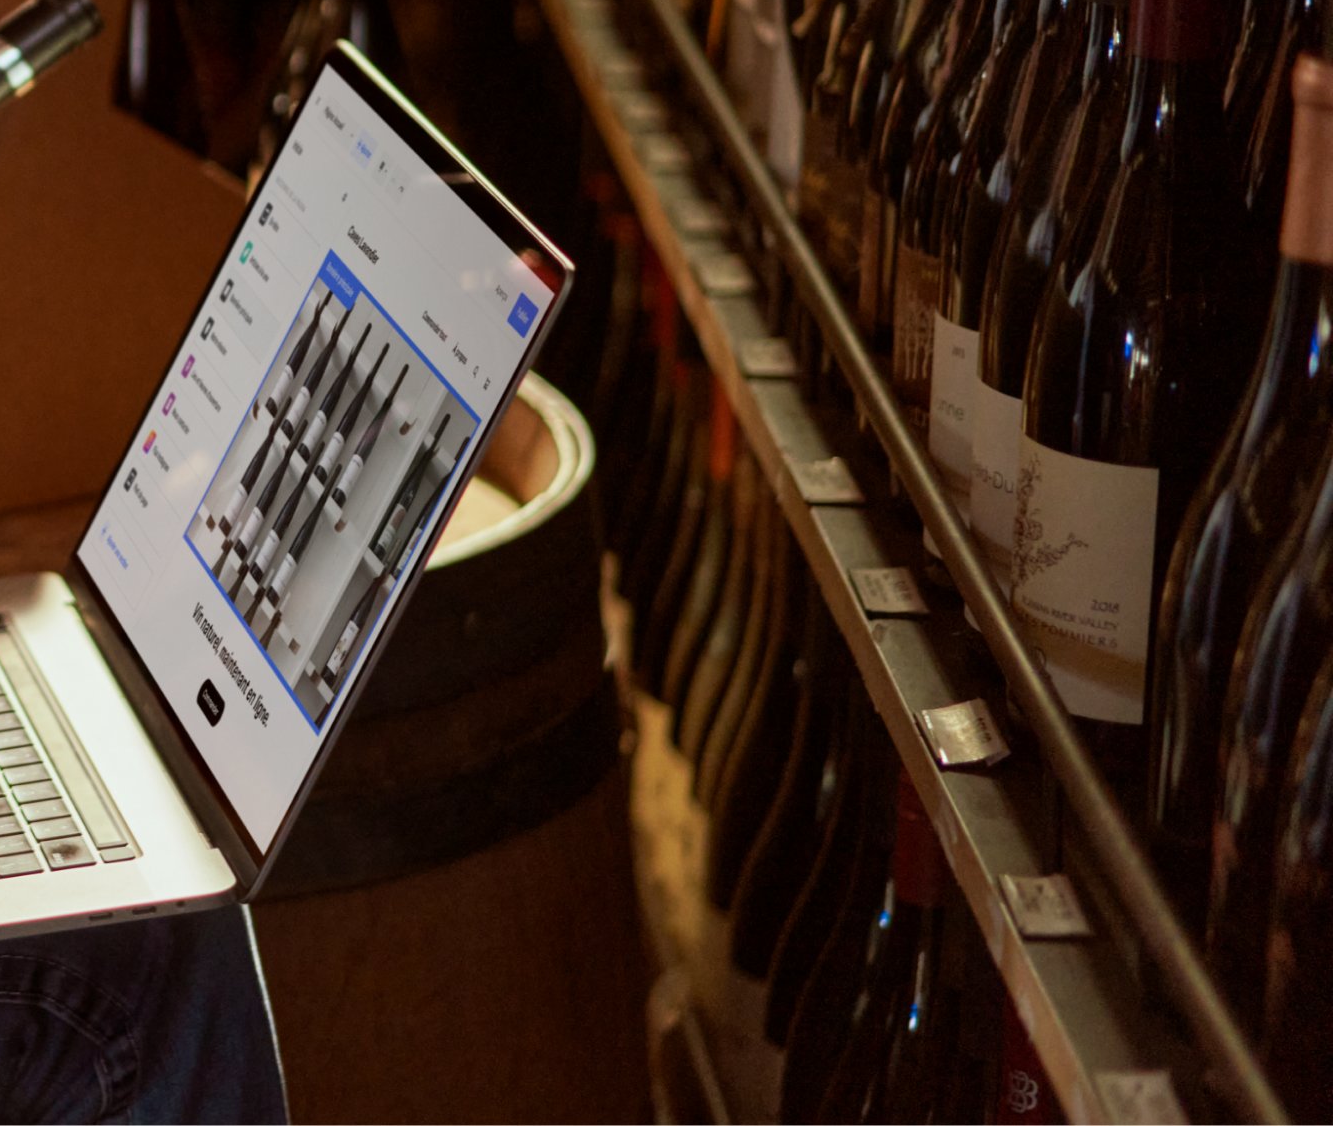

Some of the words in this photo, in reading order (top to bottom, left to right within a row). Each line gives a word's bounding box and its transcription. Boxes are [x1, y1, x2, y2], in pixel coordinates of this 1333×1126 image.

[192, 601, 204, 625] Vin
[200, 618, 223, 655] naturel,
[218, 645, 250, 695] maintenant
[252, 693, 270, 728] ligne.
